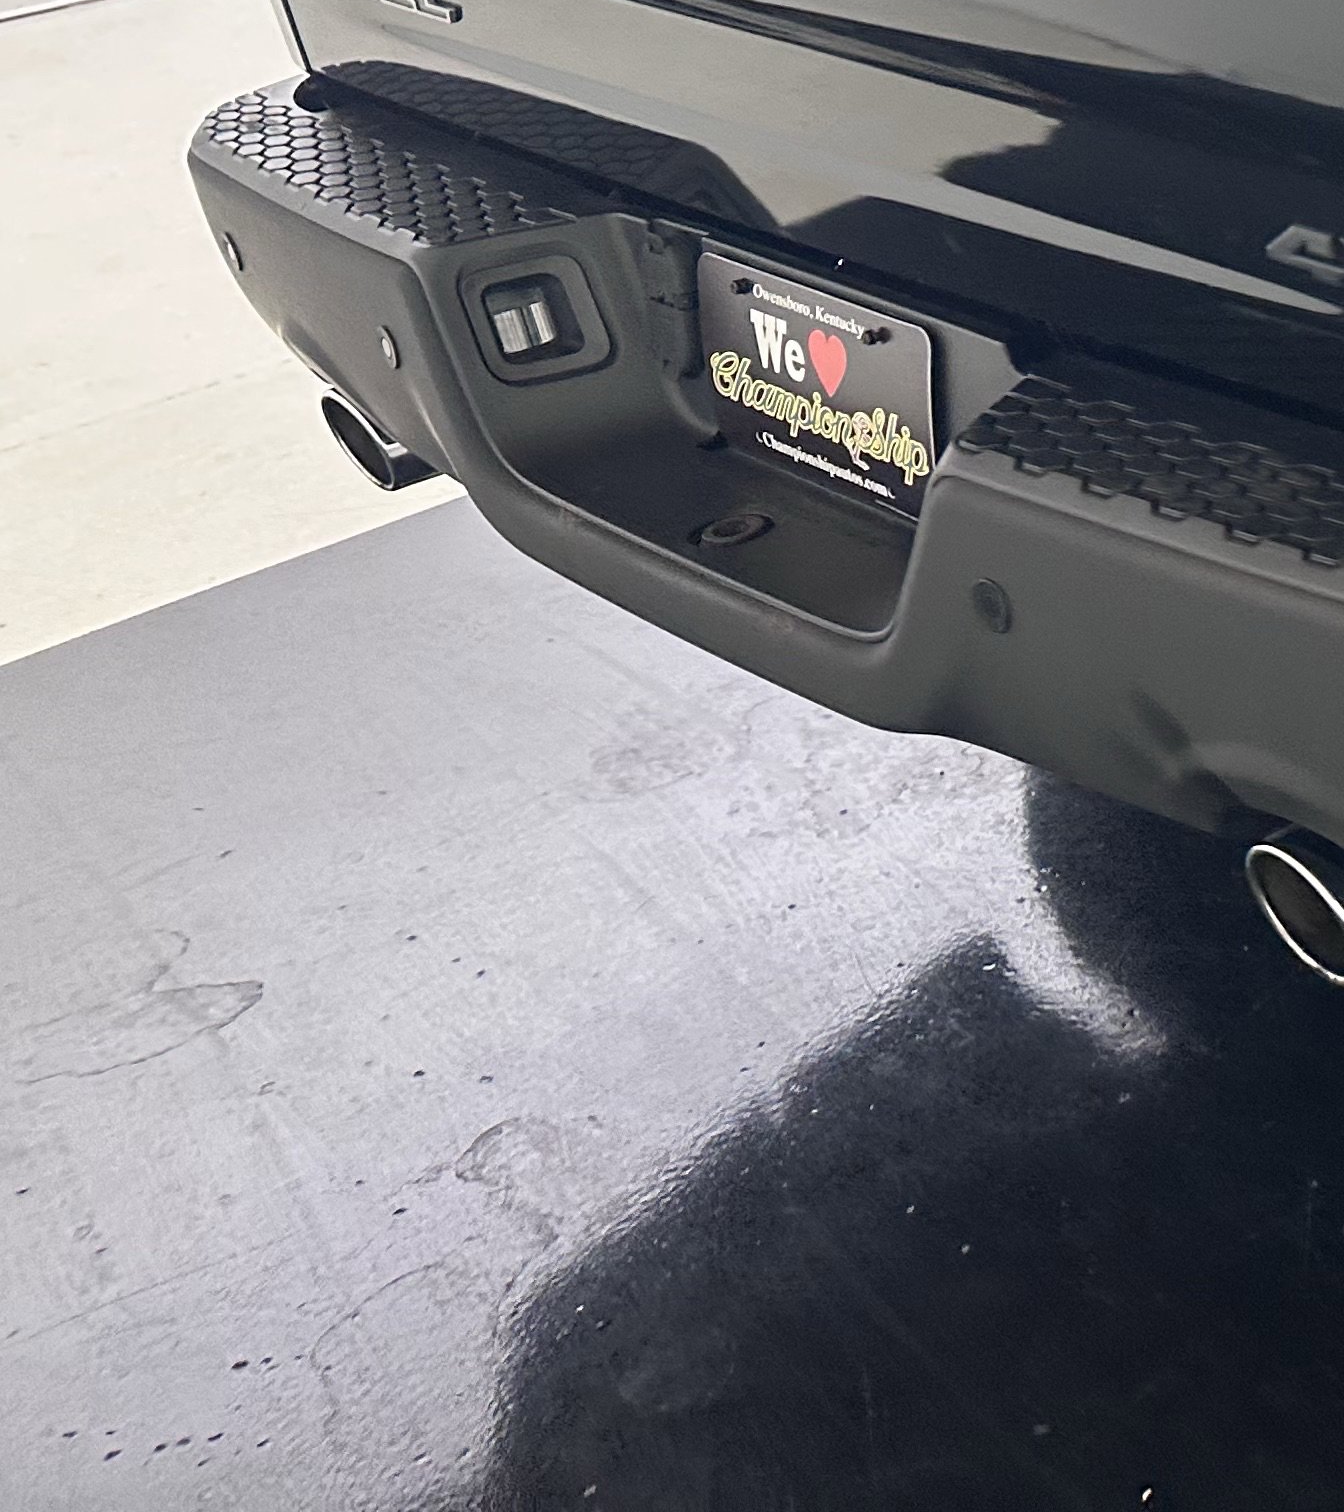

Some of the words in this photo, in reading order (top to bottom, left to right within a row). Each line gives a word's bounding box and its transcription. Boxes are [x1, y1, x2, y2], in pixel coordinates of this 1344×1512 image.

[751, 282, 814, 320] Owensboro,
[815, 304, 867, 340] Kentucky
[750, 308, 806, 382] We
